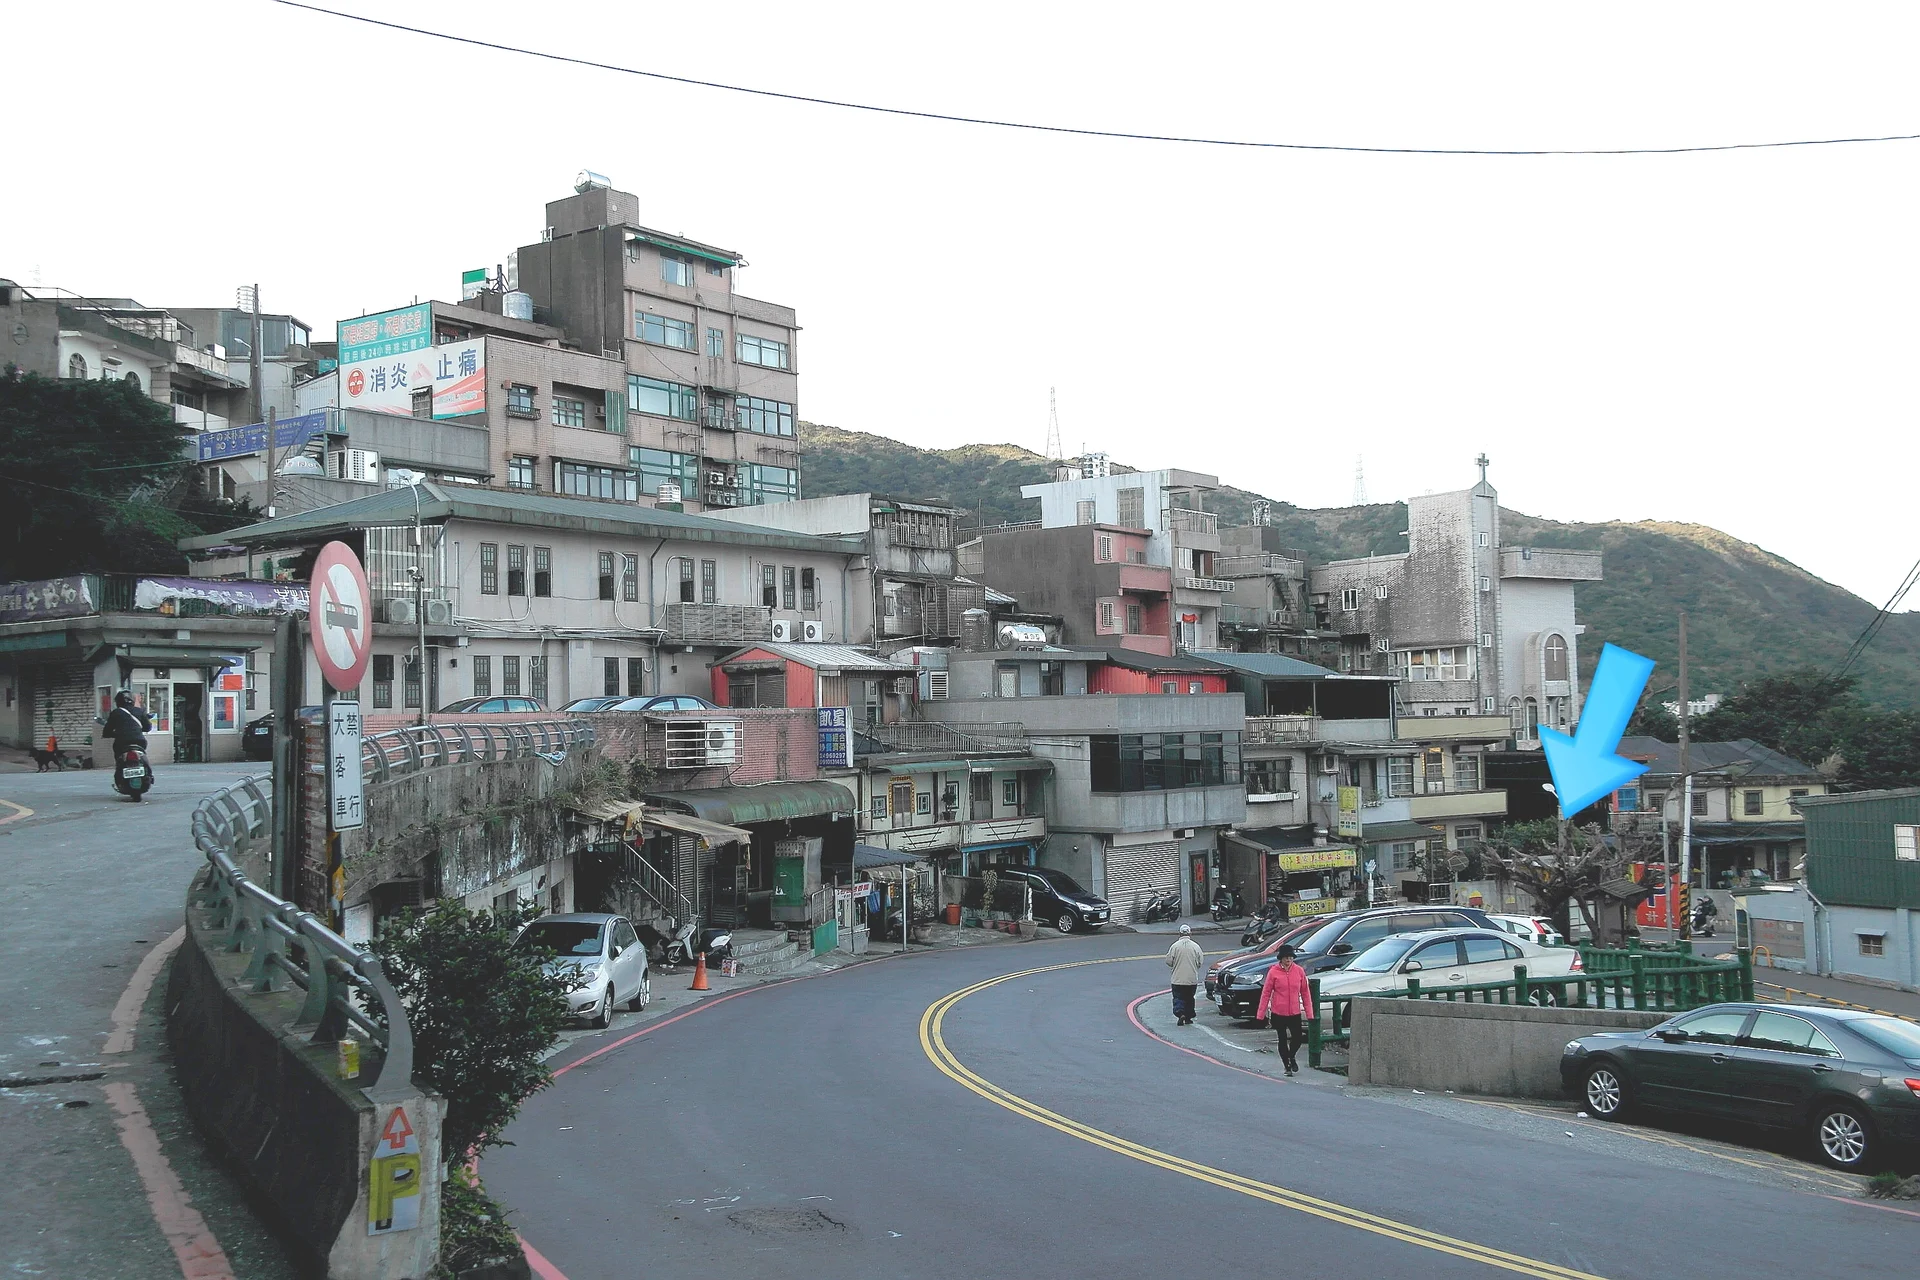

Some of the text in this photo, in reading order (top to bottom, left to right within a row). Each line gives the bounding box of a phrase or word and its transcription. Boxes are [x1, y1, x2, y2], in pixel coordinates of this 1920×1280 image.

[370, 348, 477, 393] 消炎 止痛
[369, 1153, 421, 1230] P
